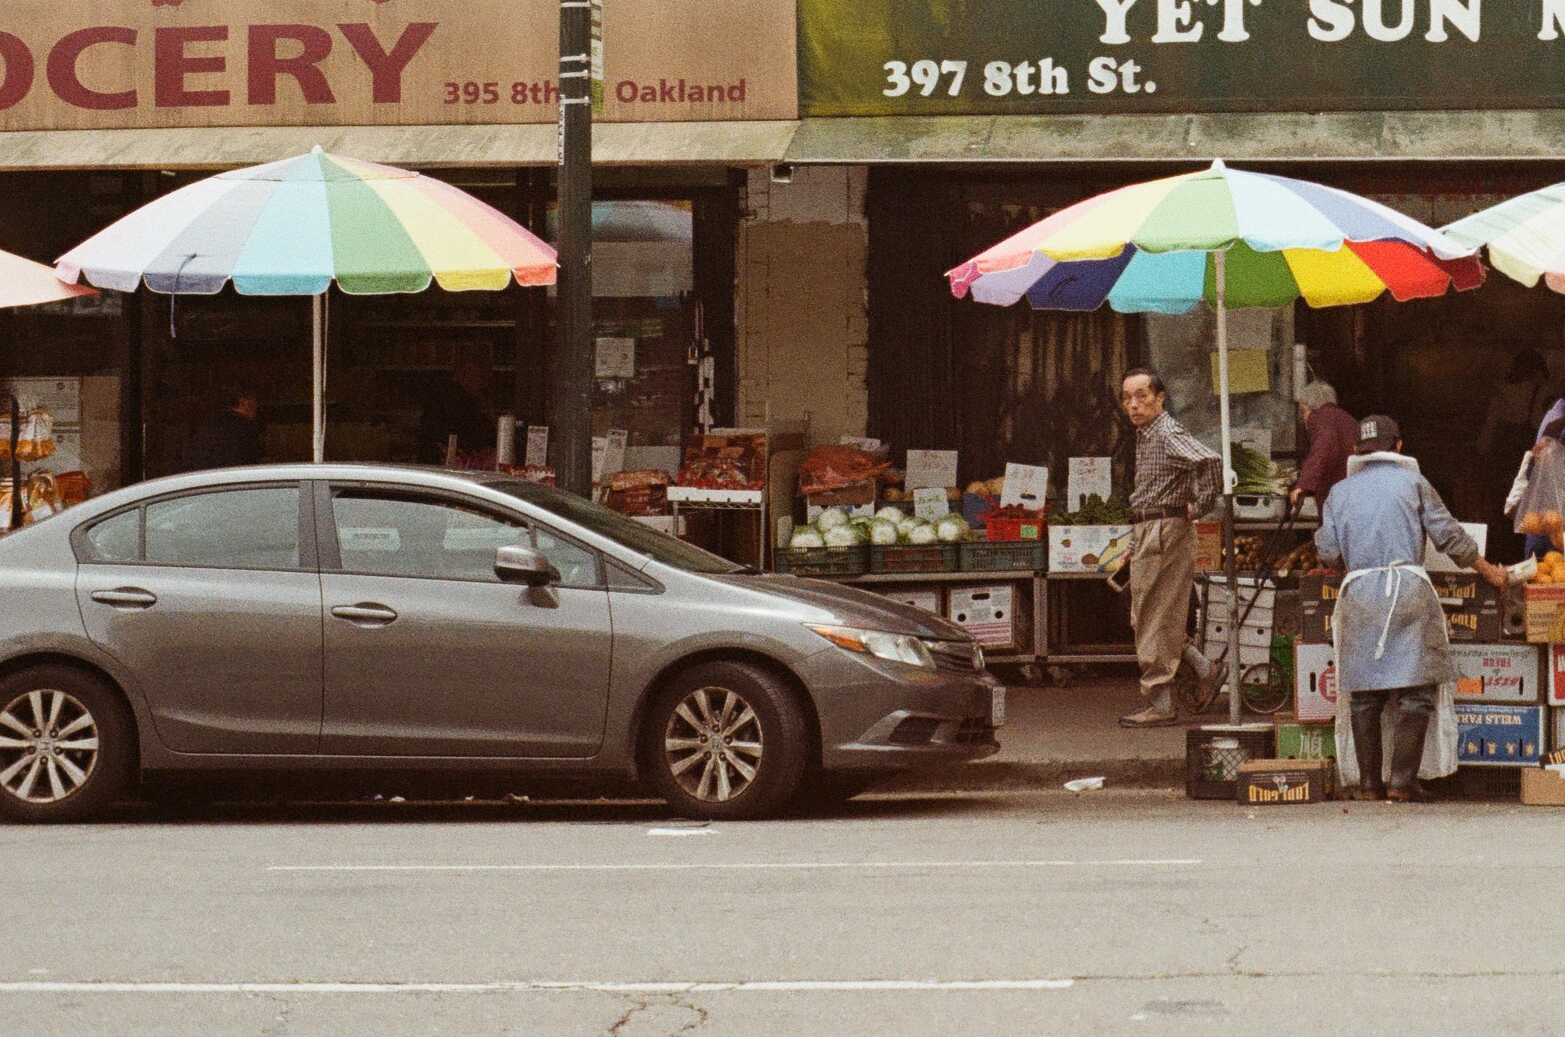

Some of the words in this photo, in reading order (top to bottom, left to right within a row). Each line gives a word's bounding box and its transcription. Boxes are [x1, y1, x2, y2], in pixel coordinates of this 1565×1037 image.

[883, 60, 967, 97] 397
[983, 57, 1070, 96] 8th
[1087, 56, 1157, 94] St.
[443, 81, 500, 106] 395
[510, 79, 560, 106] 8th
[615, 78, 747, 104] Oakland
[1484, 714, 1522, 726] WELLS
